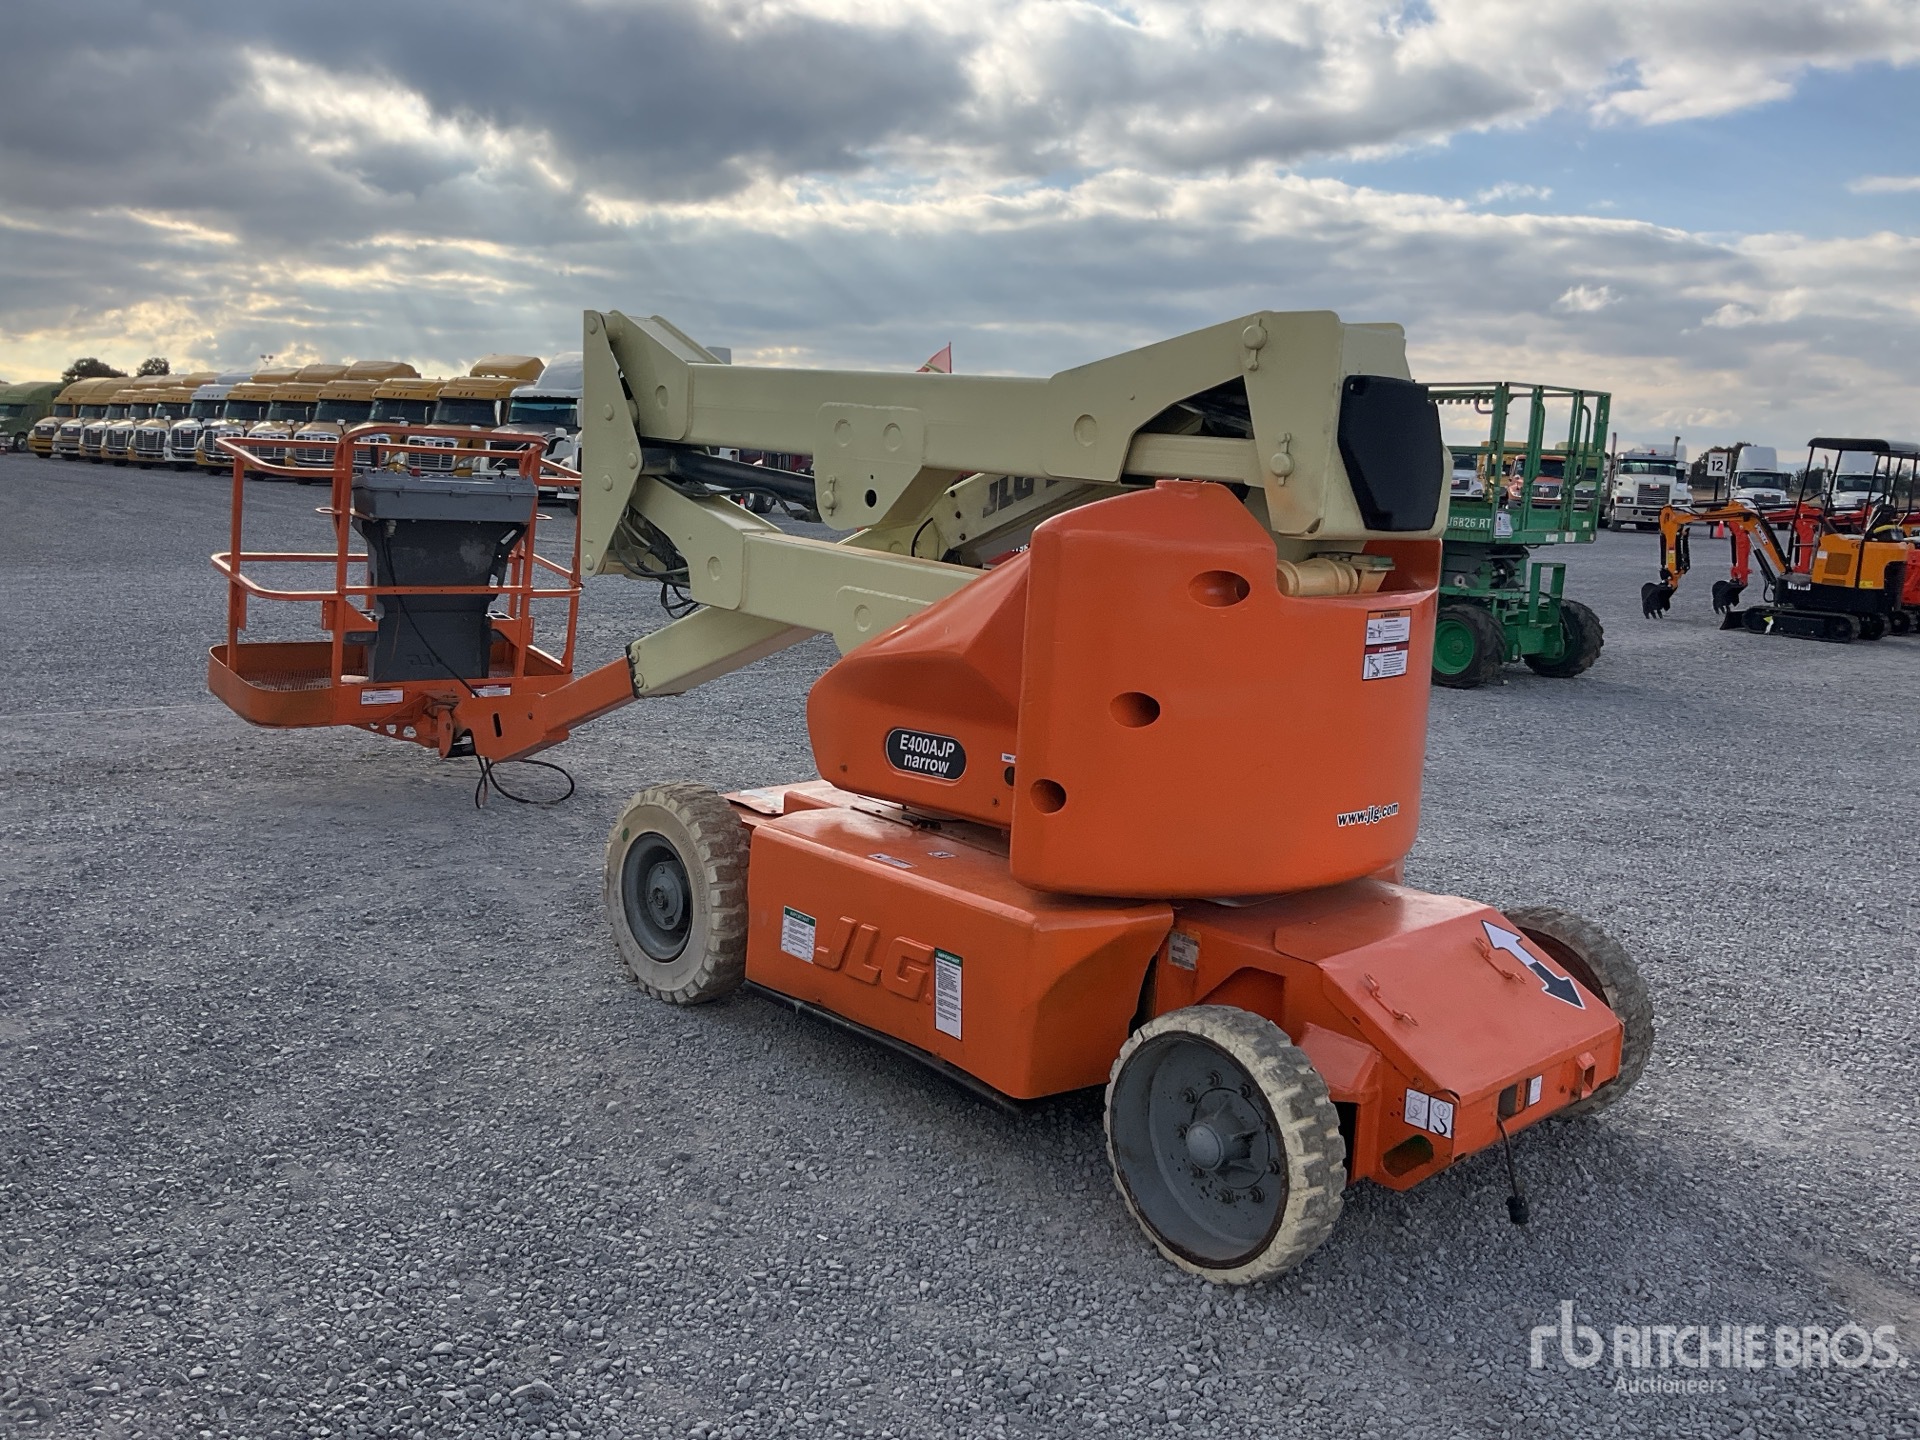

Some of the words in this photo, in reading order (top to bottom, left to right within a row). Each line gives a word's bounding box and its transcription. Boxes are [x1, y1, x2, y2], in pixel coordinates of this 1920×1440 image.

[1711, 460, 1723, 472] 12
[1478, 518, 1492, 529] RT
[899, 733, 955, 758] E400AJP
[903, 753, 950, 774] narrow
[1336, 802, 1399, 827] www.jlg.com
[813, 915, 934, 1002] JLG
